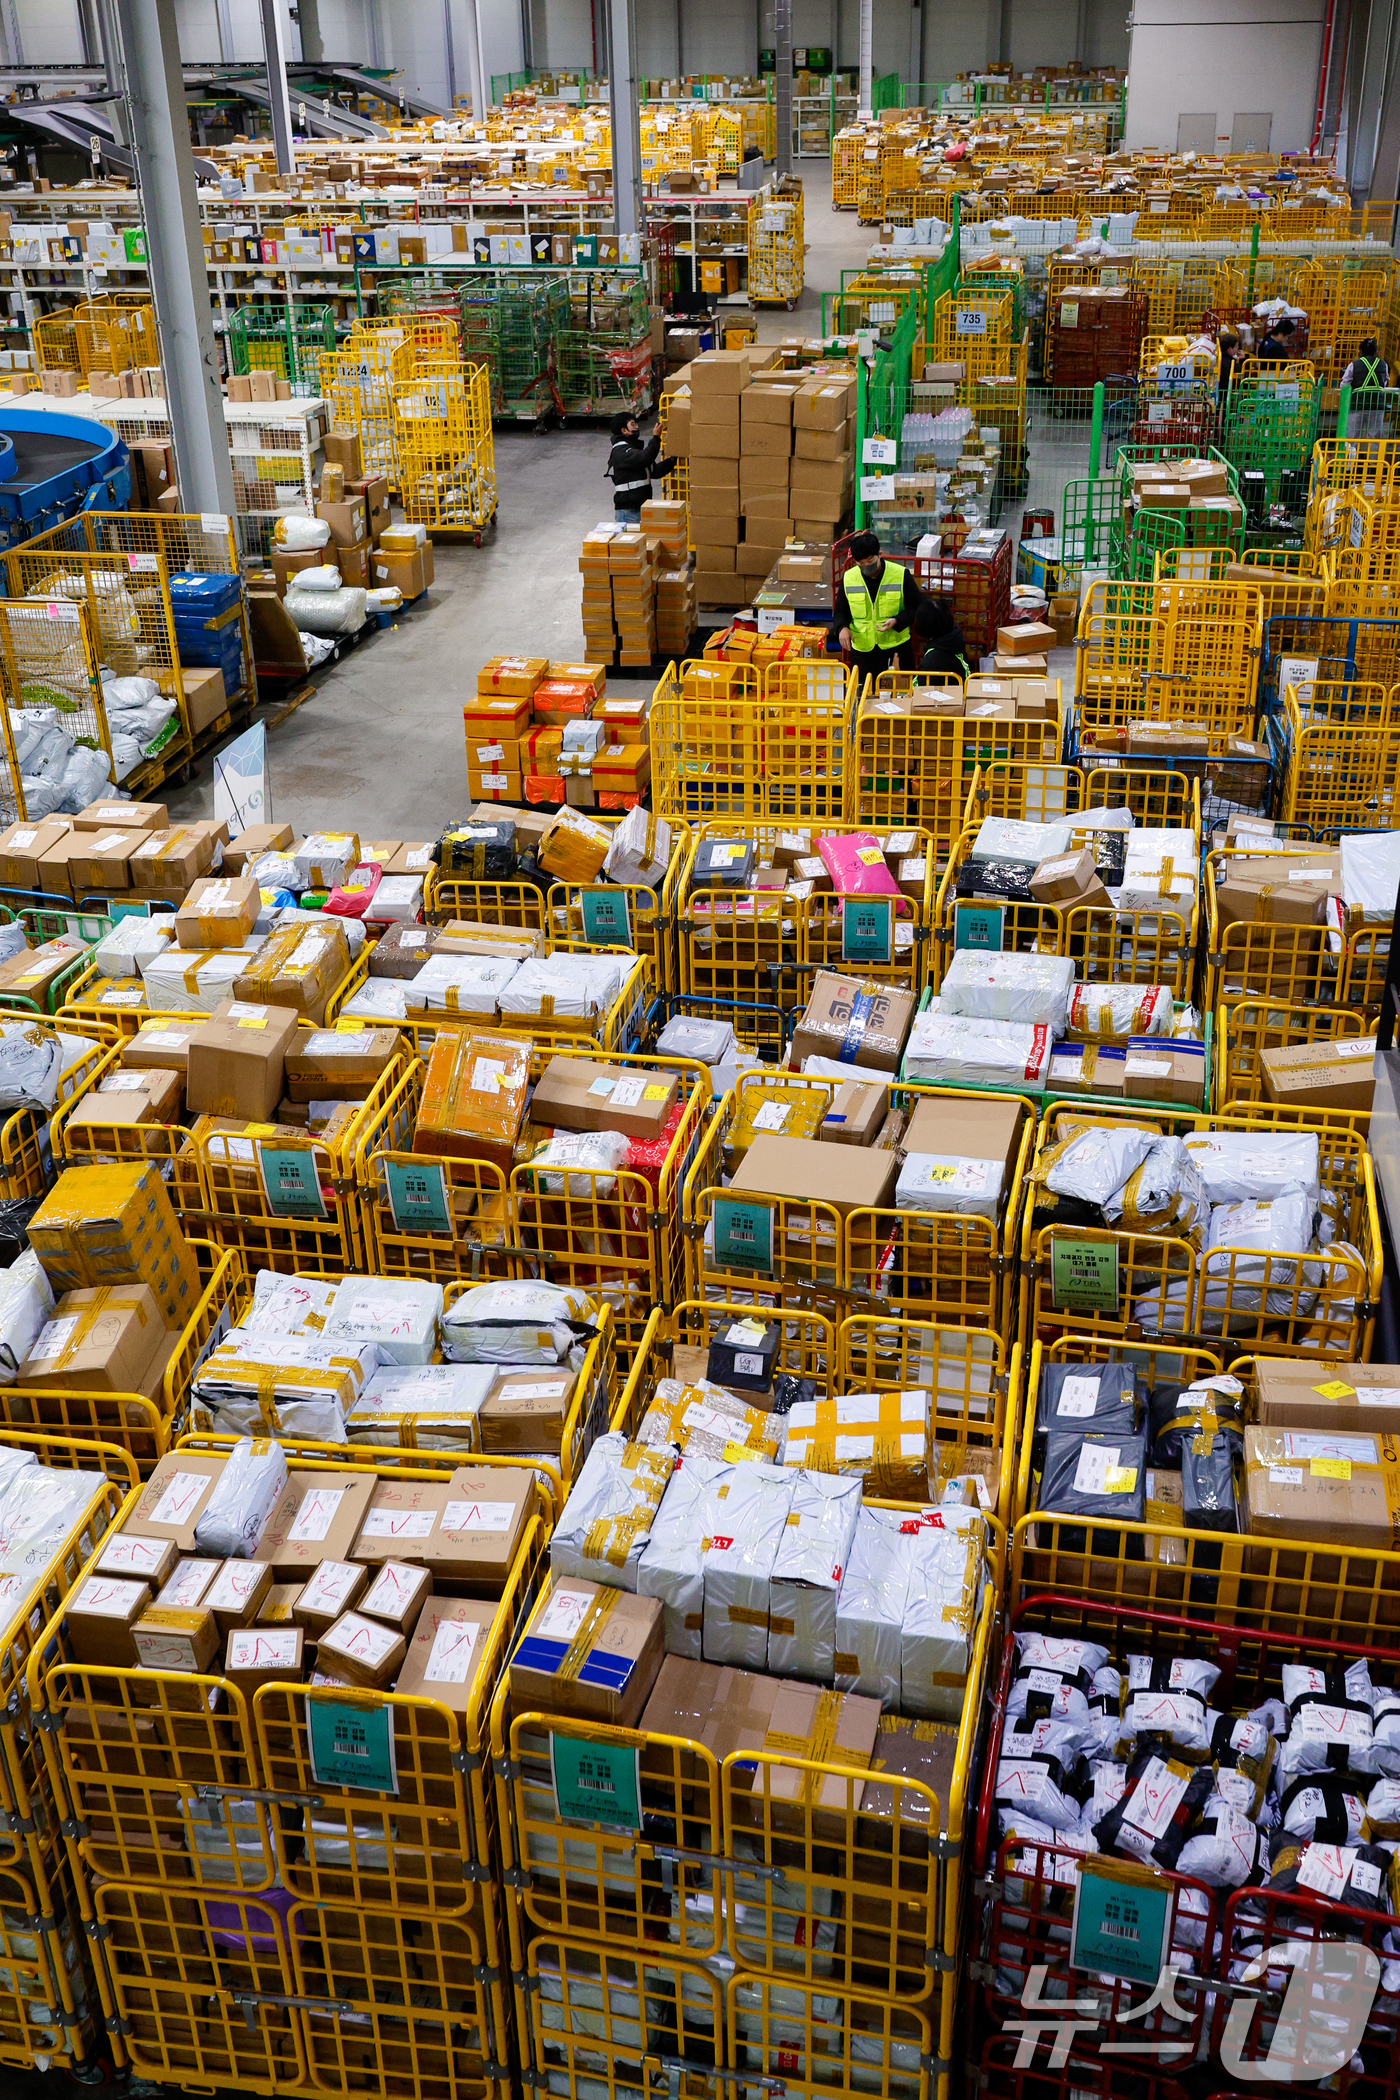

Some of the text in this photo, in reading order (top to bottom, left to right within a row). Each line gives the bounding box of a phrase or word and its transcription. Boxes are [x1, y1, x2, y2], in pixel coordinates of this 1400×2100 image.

[91, 137, 100, 149] 26
[962, 314, 981, 323] 735
[1165, 367, 1187, 378] 700
